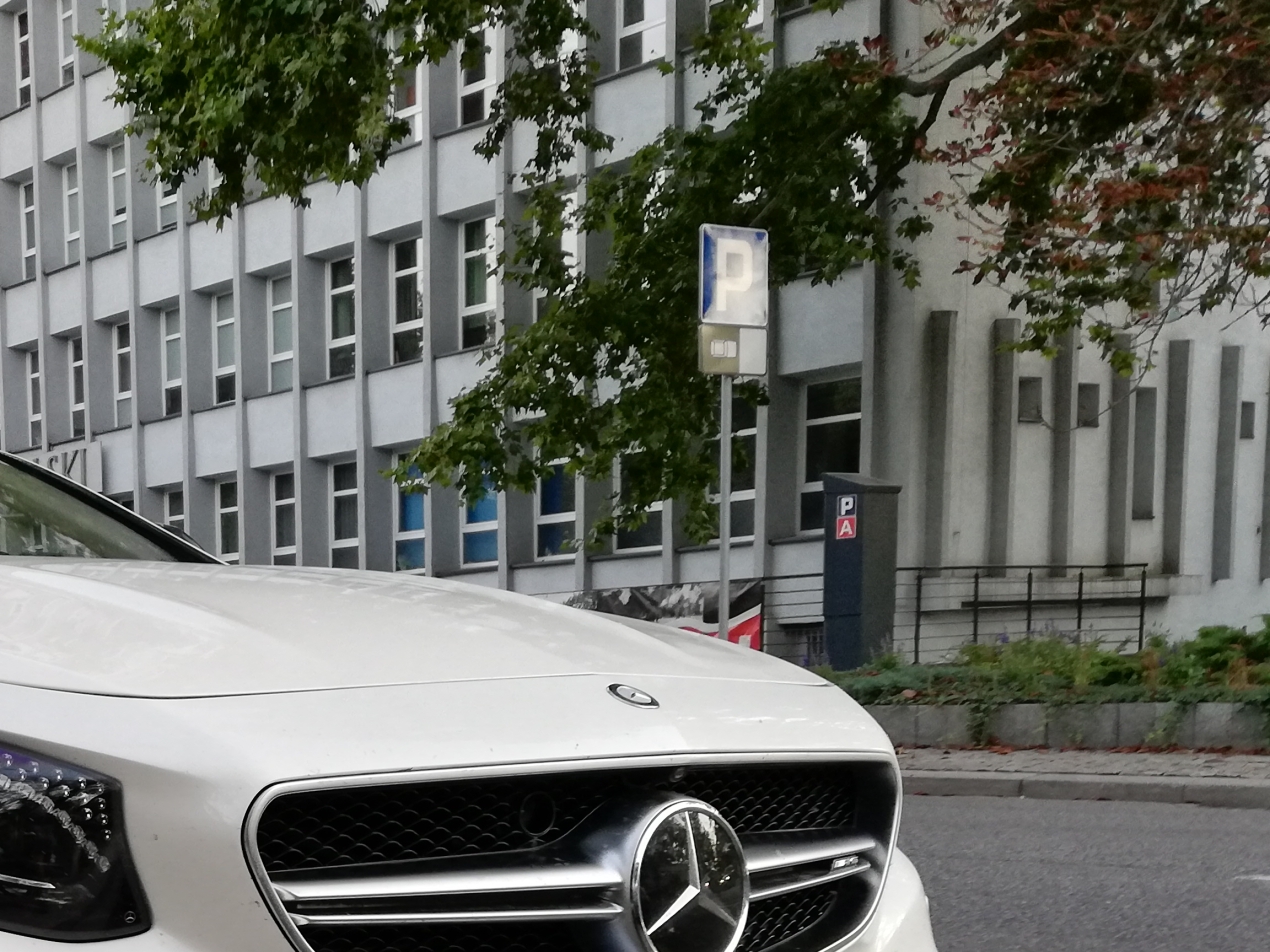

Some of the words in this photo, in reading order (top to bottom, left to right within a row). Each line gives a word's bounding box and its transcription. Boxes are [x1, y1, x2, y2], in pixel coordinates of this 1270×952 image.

[716, 237, 753, 312] P
[840, 496, 854, 516] P
[839, 519, 853, 537] A
